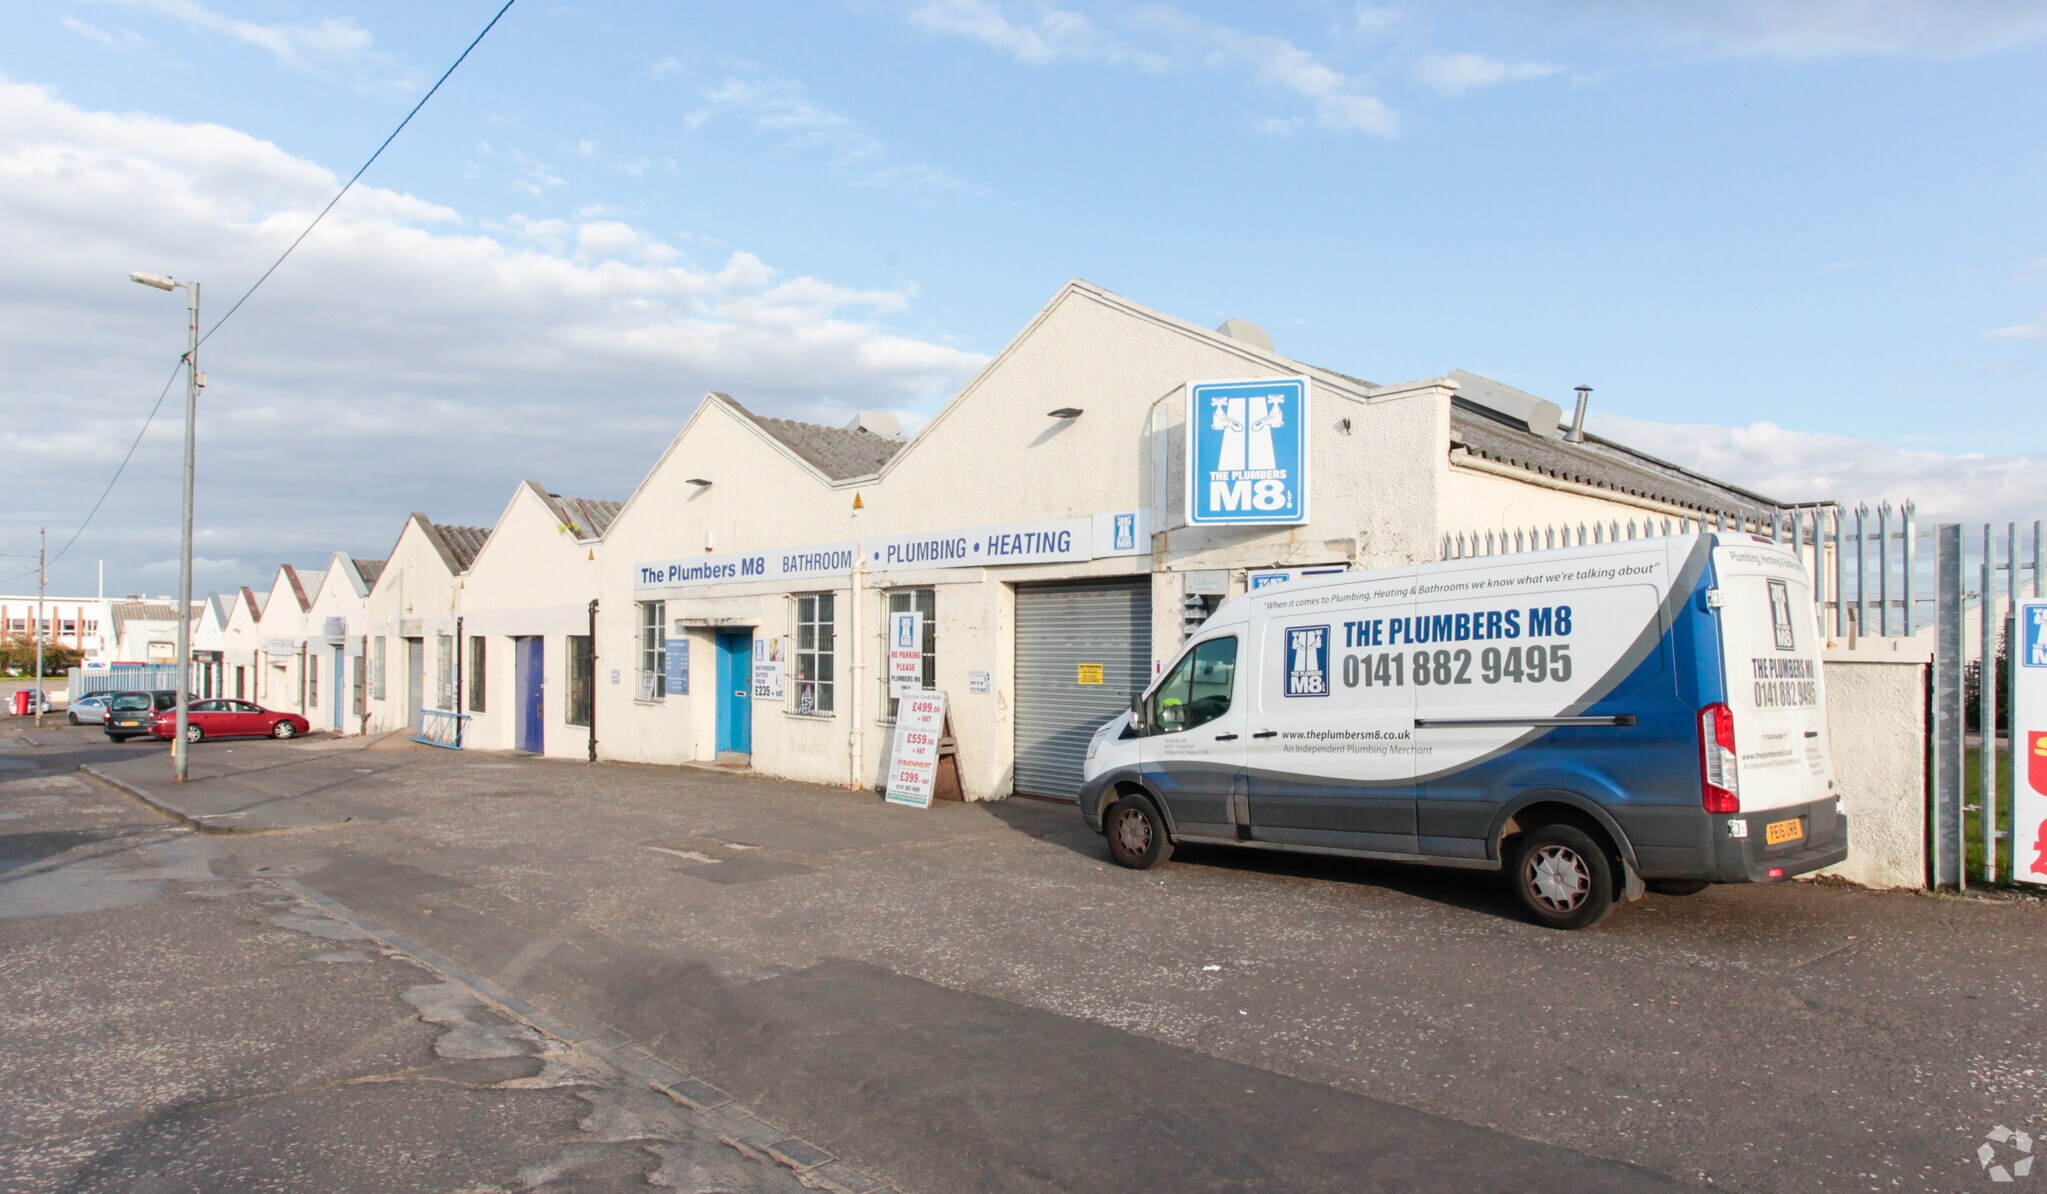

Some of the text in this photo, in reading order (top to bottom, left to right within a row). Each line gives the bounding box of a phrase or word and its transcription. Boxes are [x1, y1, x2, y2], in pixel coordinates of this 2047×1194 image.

[1210, 469, 1287, 482] THE PLUMBERS
[1210, 479, 1286, 512] M8
[887, 530, 1072, 564] PLUMBING HEATING
[641, 550, 852, 584] The Plumbers M8 BATHROOM
[1288, 600, 1294, 608] it
[1296, 598, 1320, 607] comes
[1321, 597, 1330, 605] to
[1331, 592, 1372, 603] Plumbing,
[1374, 588, 1408, 599] Heating
[1410, 586, 1417, 595] &
[1418, 582, 1470, 595] Bathrooms
[1471, 580, 1485, 589] we
[1487, 578, 1514, 588] know
[1517, 574, 1543, 585] what
[1545, 571, 1573, 583] we're
[1576, 567, 1616, 580] talking
[1343, 605, 1572, 648] THE PLUMBERS M8
[1777, 629, 1792, 647] M8
[891, 650, 921, 659] NO PARKING
[896, 663, 916, 672] PLEASE
[1343, 643, 1572, 689] 0141 882 9495
[1751, 658, 1768, 679] THE
[1769, 658, 1805, 679] PLUMBERS
[891, 675, 913, 683] PLUMBERS
[1291, 675, 1323, 694] M8
[755, 685, 770, 697] £235
[1754, 681, 1816, 708] 0141 882 9495
[912, 701, 941, 714] £499.00
[907, 733, 935, 746] £559.00
[1282, 730, 1411, 741] www.theplumbersm8.co.uk
[916, 747, 926, 755] VAT
[1283, 744, 1433, 757] An Independent Plumbing Merchant
[900, 771, 919, 784] £399
